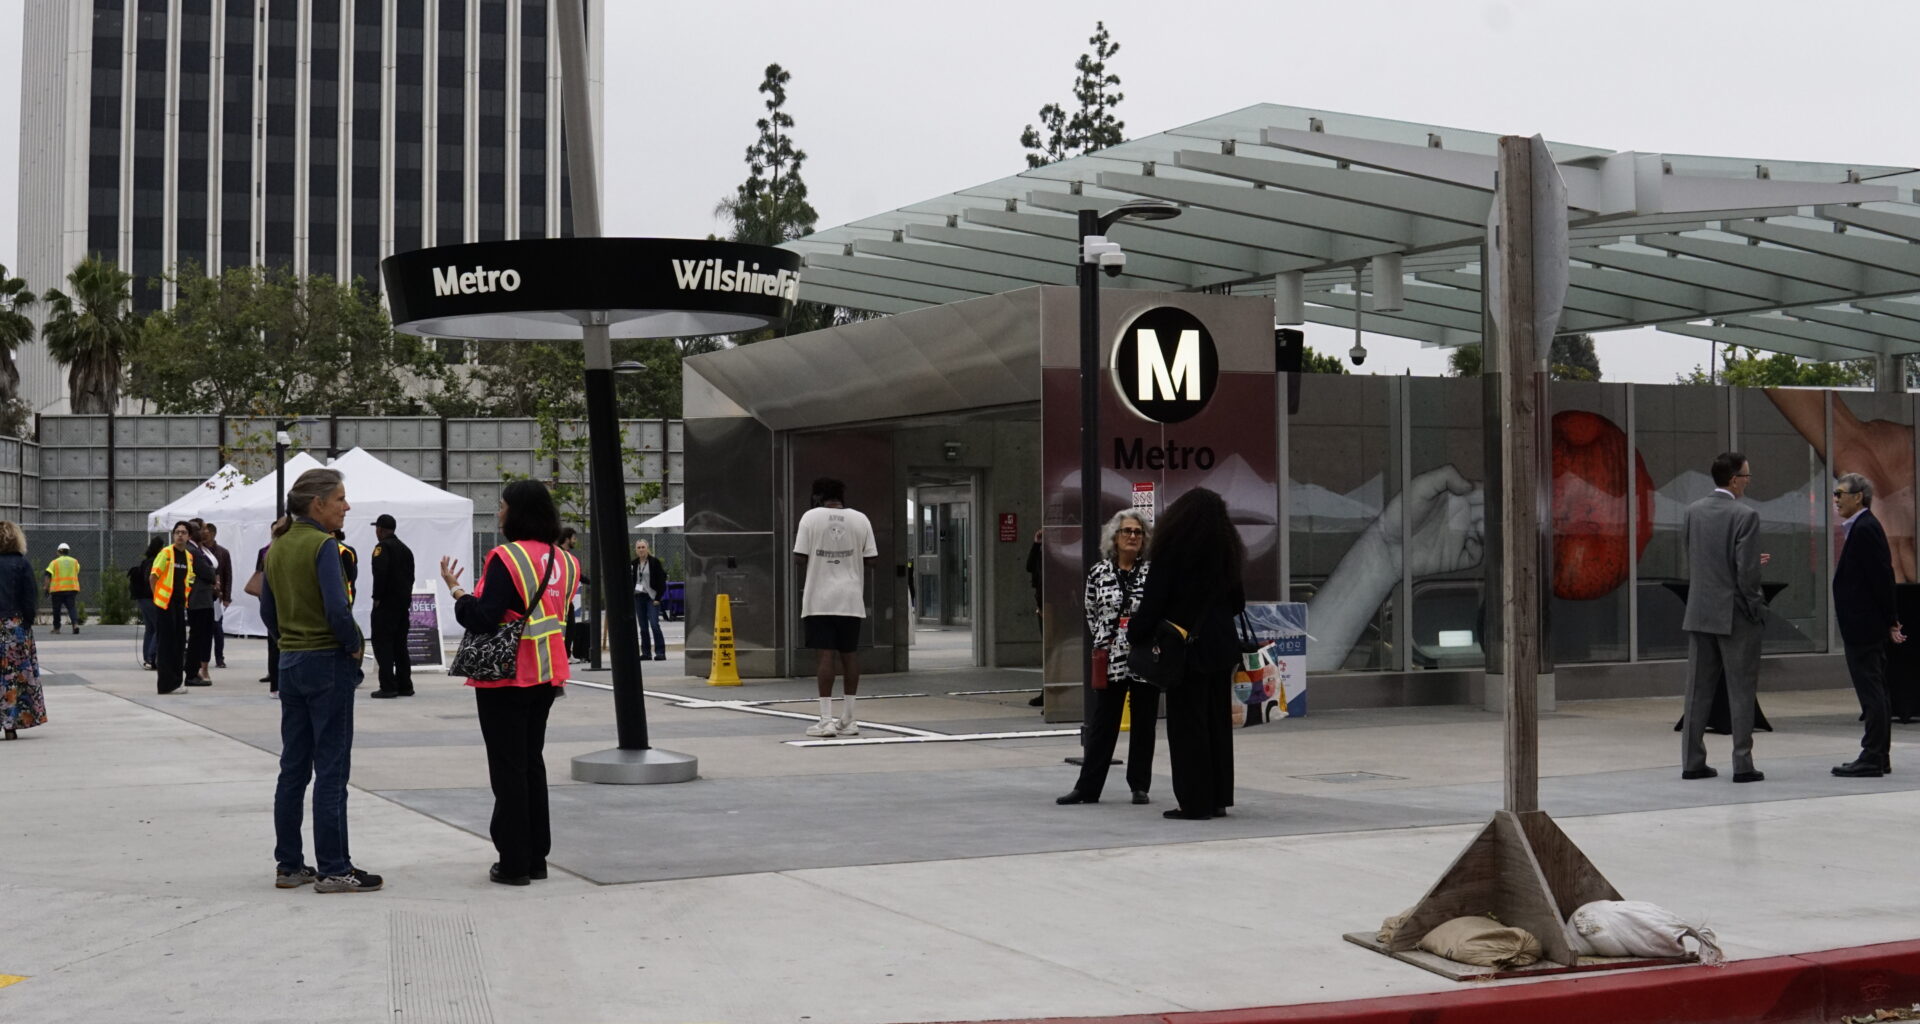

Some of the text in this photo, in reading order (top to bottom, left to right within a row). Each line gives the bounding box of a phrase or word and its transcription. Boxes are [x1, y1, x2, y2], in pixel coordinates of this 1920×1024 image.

[432, 265, 522, 297] Metro
[672, 258, 800, 306] Wilshire/Fai
[1137, 329, 1200, 401] M
[1113, 437, 1216, 470] Metro
